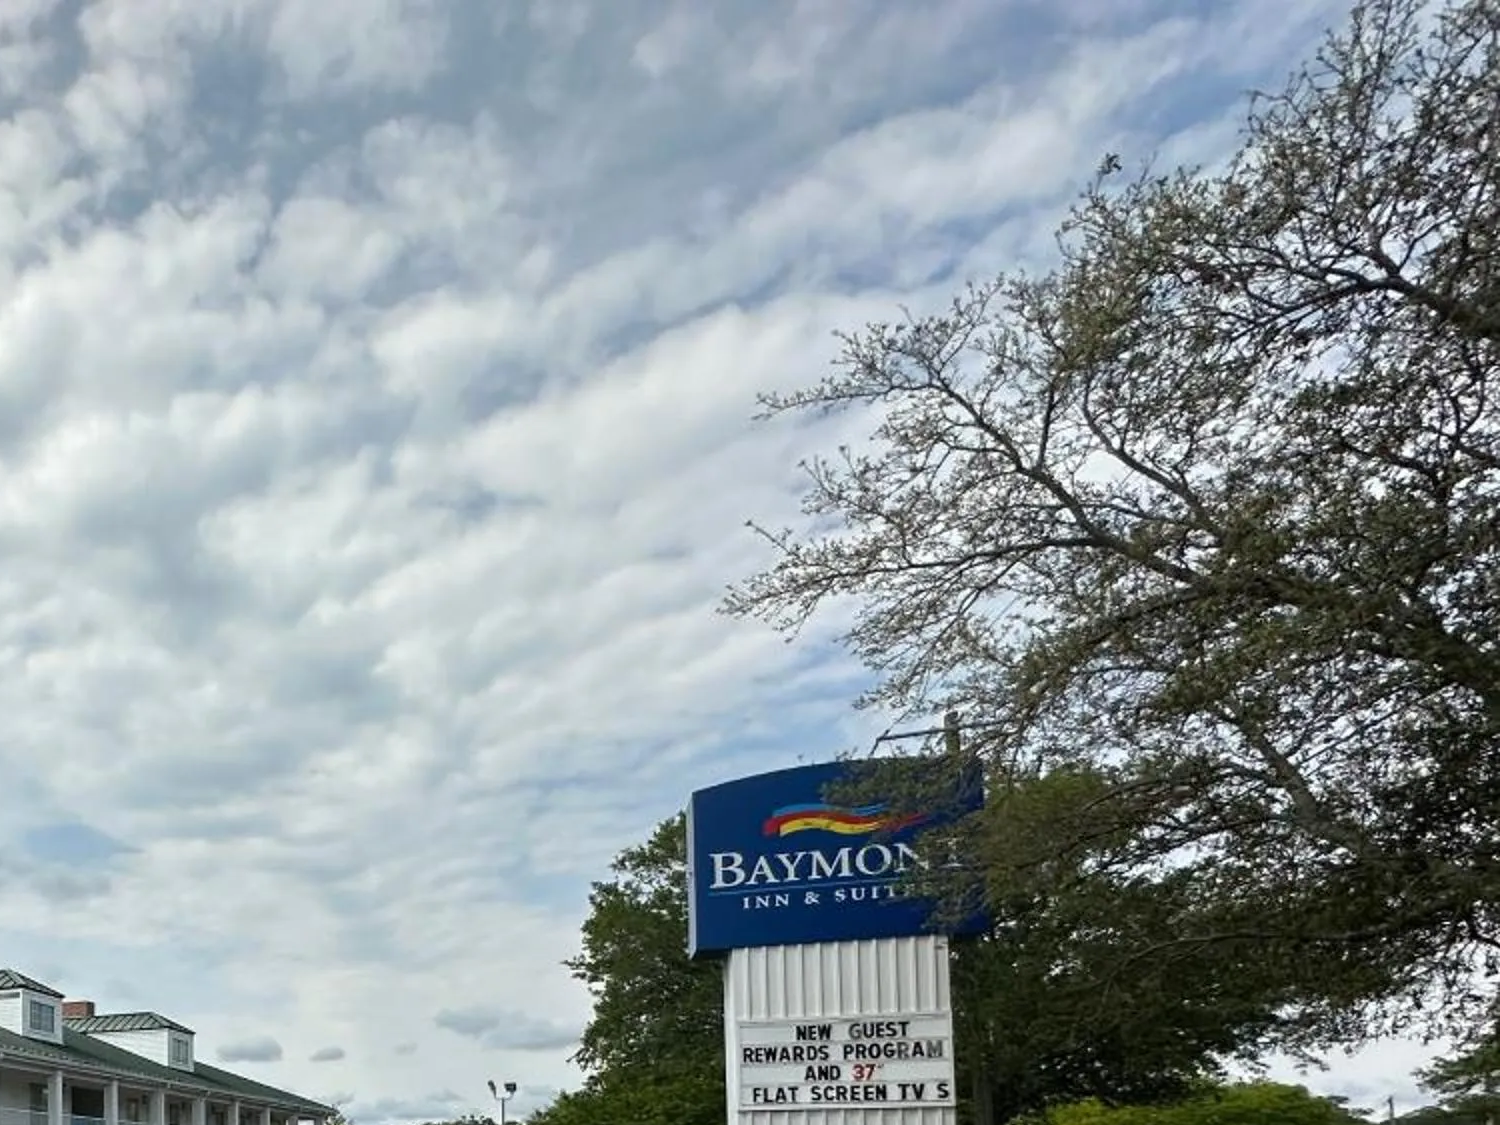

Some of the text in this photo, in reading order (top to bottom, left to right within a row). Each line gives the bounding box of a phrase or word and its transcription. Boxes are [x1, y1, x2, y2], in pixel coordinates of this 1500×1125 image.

[742, 893, 790, 909] INN
[804, 891, 821, 905] &
[796, 1021, 910, 1041] NEW GUEST
[743, 1040, 943, 1063] REWARDS PROGRAM
[804, 1065, 841, 1081] AND
[753, 1087, 799, 1104] FLAT
[811, 1084, 887, 1101] SCREEN
